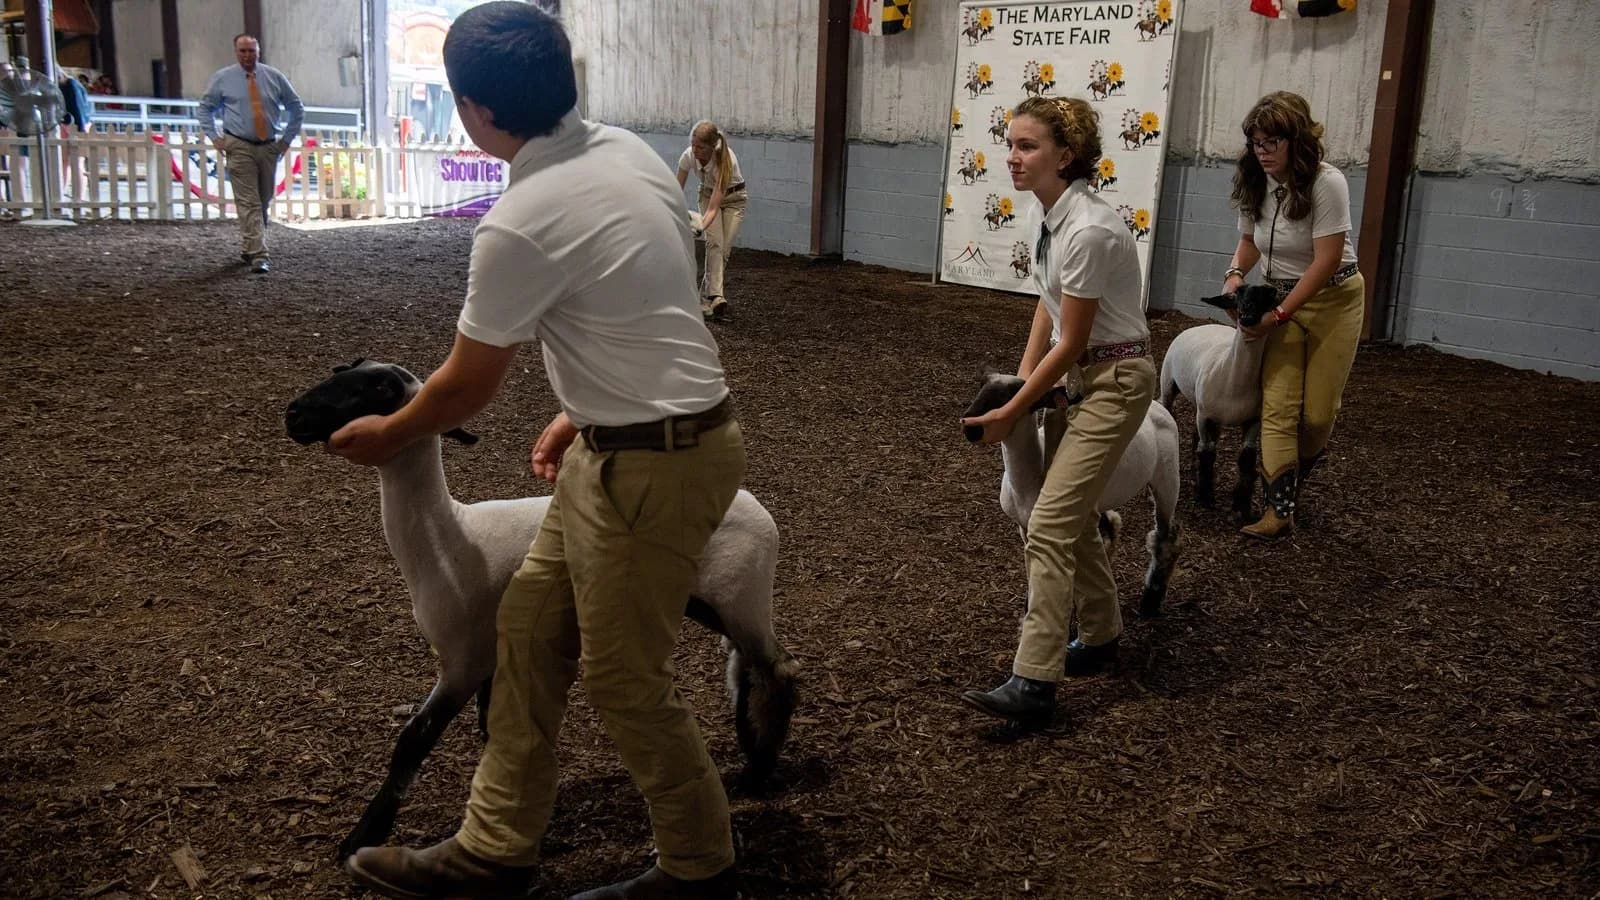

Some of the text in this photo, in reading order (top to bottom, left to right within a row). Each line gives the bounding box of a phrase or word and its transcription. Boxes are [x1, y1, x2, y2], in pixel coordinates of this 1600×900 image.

[997, 4, 1133, 24] THE MARYLAND
[1012, 27, 1110, 46] STATE FAIR
